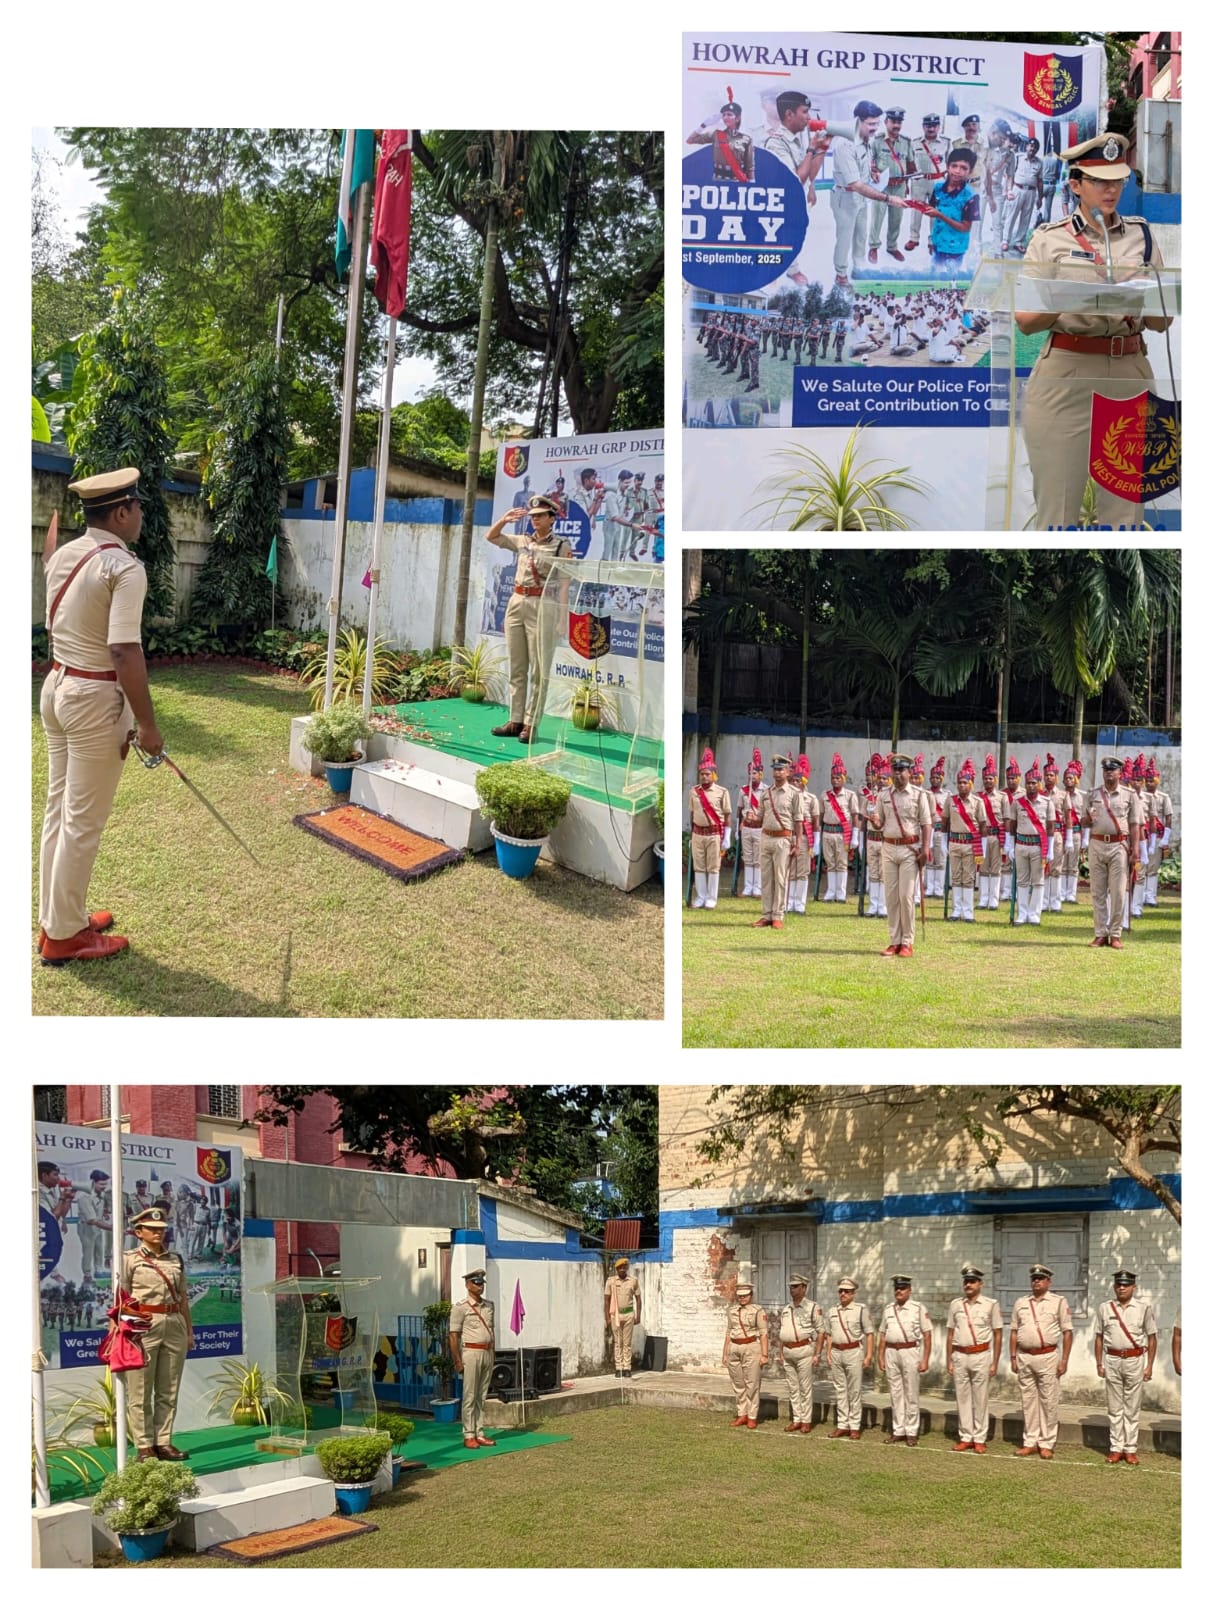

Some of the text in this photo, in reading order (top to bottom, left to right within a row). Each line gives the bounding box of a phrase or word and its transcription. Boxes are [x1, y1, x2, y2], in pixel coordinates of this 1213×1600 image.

[691, 42, 985, 76] HOWRAH GRP DISTRICT
[1027, 84, 1039, 101] WEST
[1063, 85, 1079, 105] POLICE
[682, 184, 785, 212] POLICE
[682, 214, 785, 242] DAY
[695, 250, 754, 266] September,
[757, 253, 782, 264] 2025
[801, 379, 829, 392] We
[832, 378, 882, 393] Salute
[886, 379, 914, 393] Our
[917, 378, 964, 393] Police
[817, 398, 861, 412] Great
[864, 398, 959, 412] Contribution
[962, 398, 981, 412] To
[545, 443, 599, 458] HOWRAH
[601, 441, 627, 454] GRP
[1091, 458, 1117, 486] WEST
[1115, 479, 1160, 493] BENGAL
[555, 663, 593, 681] HOWRAH
[337, 815, 417, 856] WELCOME
[62, 1136, 97, 1151] GRP
[101, 1141, 175, 1160] DSTRICT
[65, 1338, 84, 1348] We
[202, 1332, 217, 1340] For
[217, 1330, 240, 1339] Their
[199, 1341, 231, 1350] Society
